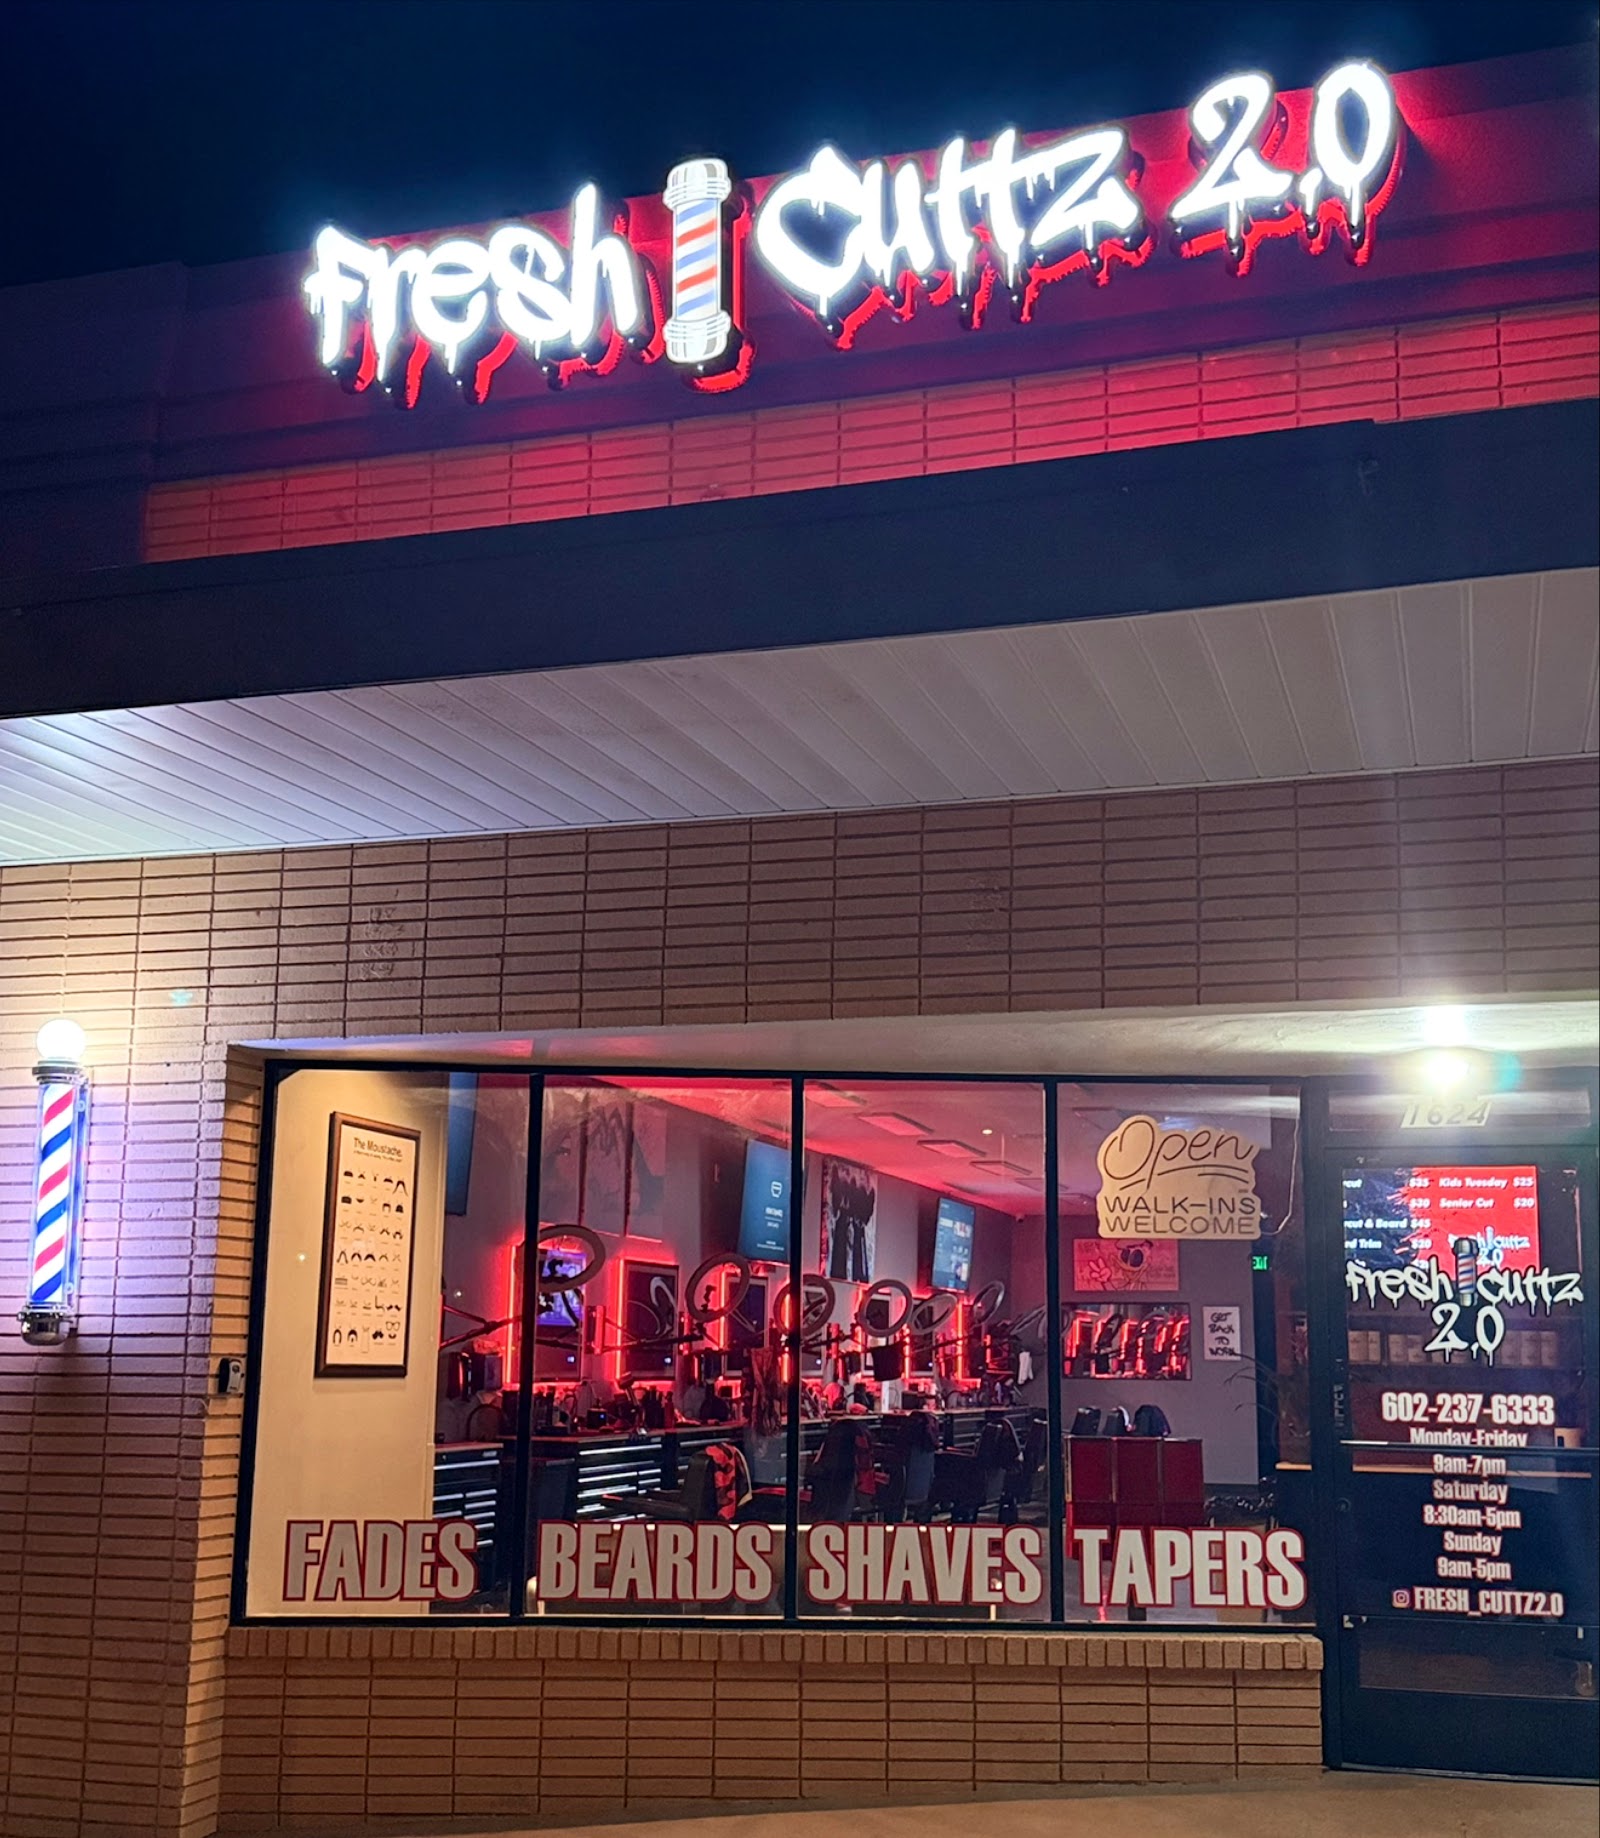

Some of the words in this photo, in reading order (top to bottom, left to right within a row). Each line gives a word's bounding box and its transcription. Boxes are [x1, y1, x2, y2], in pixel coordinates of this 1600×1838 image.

[1171, 60, 1398, 246] 2.0
[1408, 1101, 1487, 1127] 1624
[1103, 1119, 1254, 1190] Open
[1439, 1177, 1462, 1188] Kids
[1465, 1176, 1508, 1189] Tuesday
[1513, 1176, 1534, 1187] $25
[1104, 1196, 1256, 1214] WALK-INS
[1475, 1197, 1495, 1208] Cut
[1513, 1197, 1536, 1208] $20
[1105, 1216, 1256, 1234] WELCOME
[1410, 1219, 1432, 1229] $45
[1359, 1239, 1382, 1249] Trim
[1411, 1239, 1433, 1250] $20
[1214, 1335, 1230, 1346] TO
[1424, 1302, 1505, 1367] 2.0
[1381, 1391, 1556, 1426] 602-237-6333
[1409, 1426, 1529, 1448] Monday-Friday
[1432, 1453, 1507, 1477] 9am-7pm
[1433, 1478, 1509, 1505] Saturday
[1422, 1503, 1522, 1531] 8:30am-5pm
[1443, 1530, 1503, 1557] Sunday
[282, 1519, 479, 1602] FADES
[536, 1519, 775, 1602] BEARDS
[806, 1521, 1043, 1605] SHAVES
[1073, 1525, 1307, 1609] TAPERS
[1436, 1556, 1512, 1582] 9am-5pm
[1413, 1586, 1565, 1617] FRESH_CUTTZ2.0
